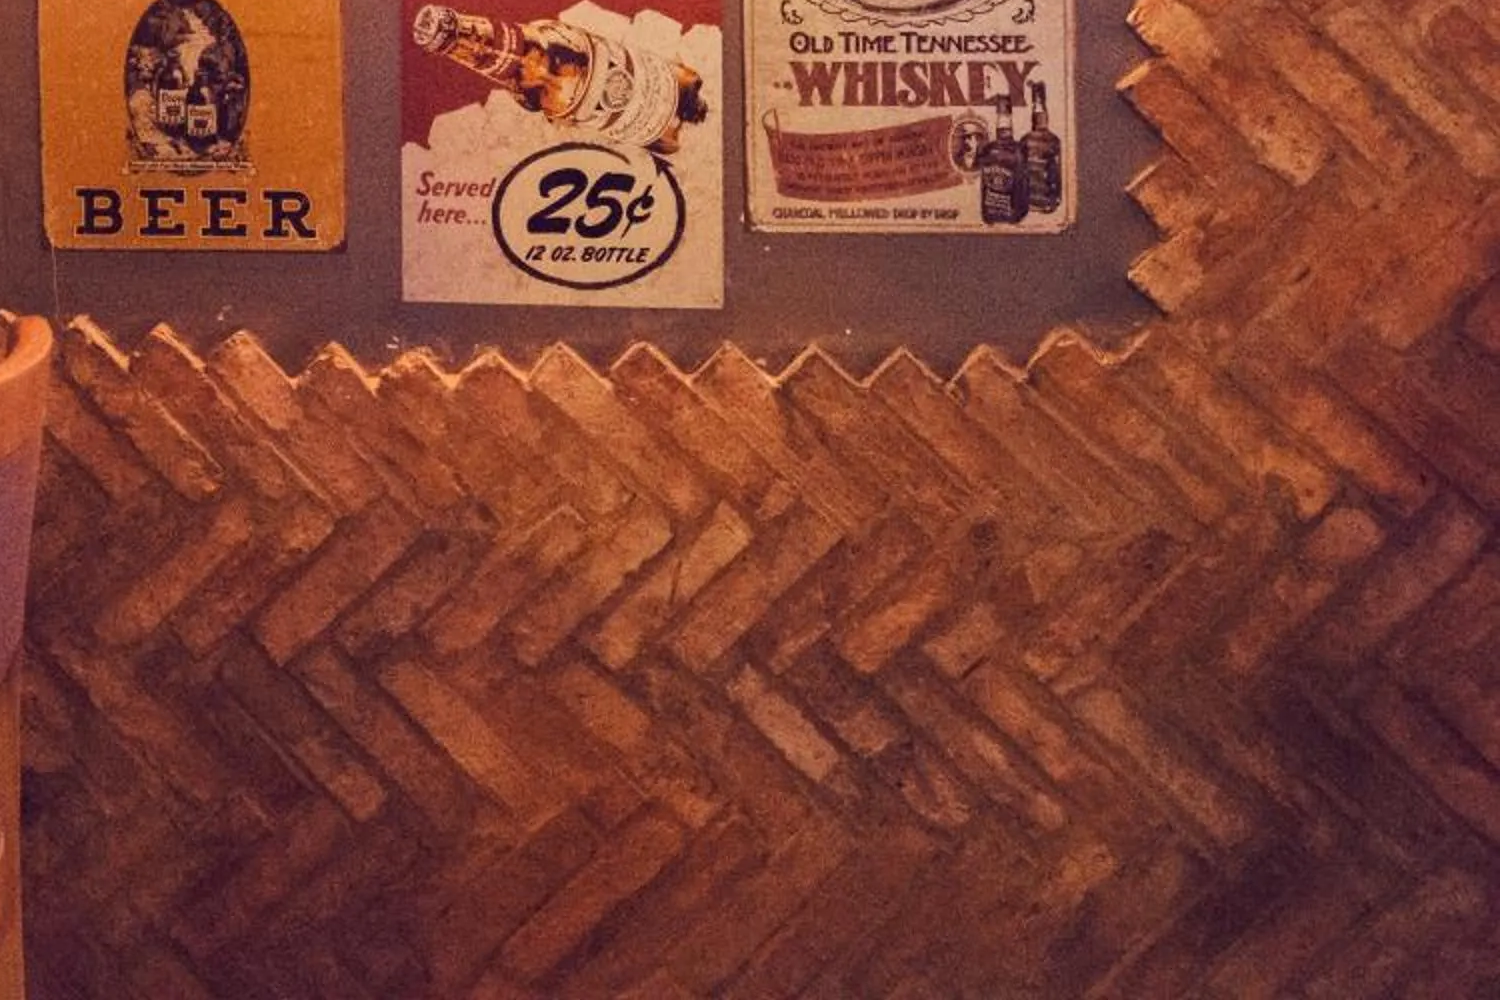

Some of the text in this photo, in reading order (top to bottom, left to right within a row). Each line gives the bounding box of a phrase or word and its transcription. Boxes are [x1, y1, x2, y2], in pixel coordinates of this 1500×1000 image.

[790, 31, 1034, 54] OLD TIME TENNESSEE
[788, 60, 1036, 108] WHISKEY
[416, 171, 495, 198] Served
[75, 189, 316, 239] BEER
[417, 201, 487, 226] here...
[526, 168, 656, 239] 25¢
[525, 246, 542, 261] 12
[581, 246, 650, 263] BOTTLE
